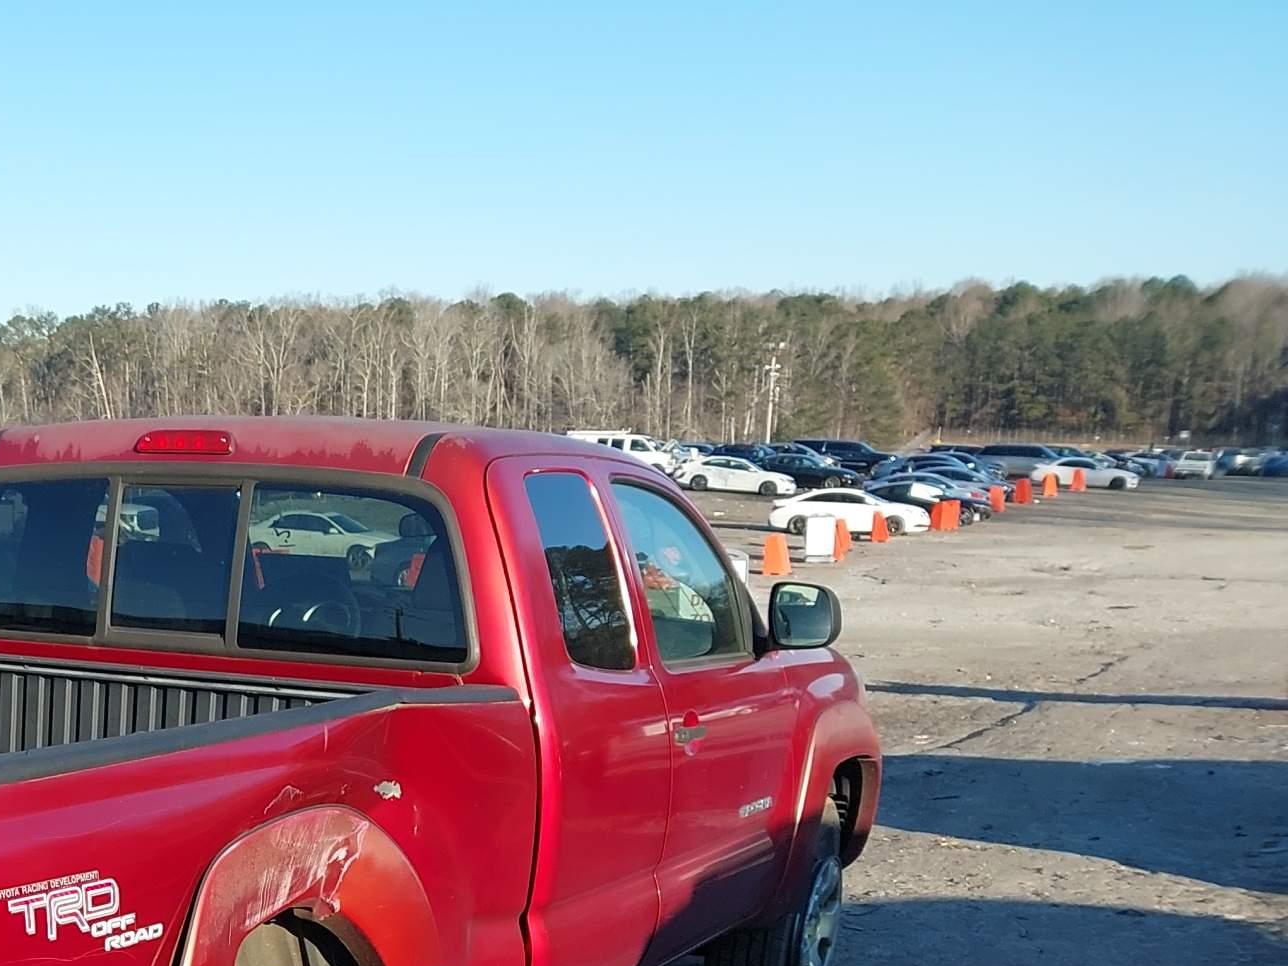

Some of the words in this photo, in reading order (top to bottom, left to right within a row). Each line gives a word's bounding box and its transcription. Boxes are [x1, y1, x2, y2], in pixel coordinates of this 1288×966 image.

[21, 881, 48, 896] RACING
[49, 871, 99, 889] DEVELOPMENT
[8, 878, 120, 942] TRD
[91, 912, 137, 938] OFF
[104, 922, 163, 952] ROAD
